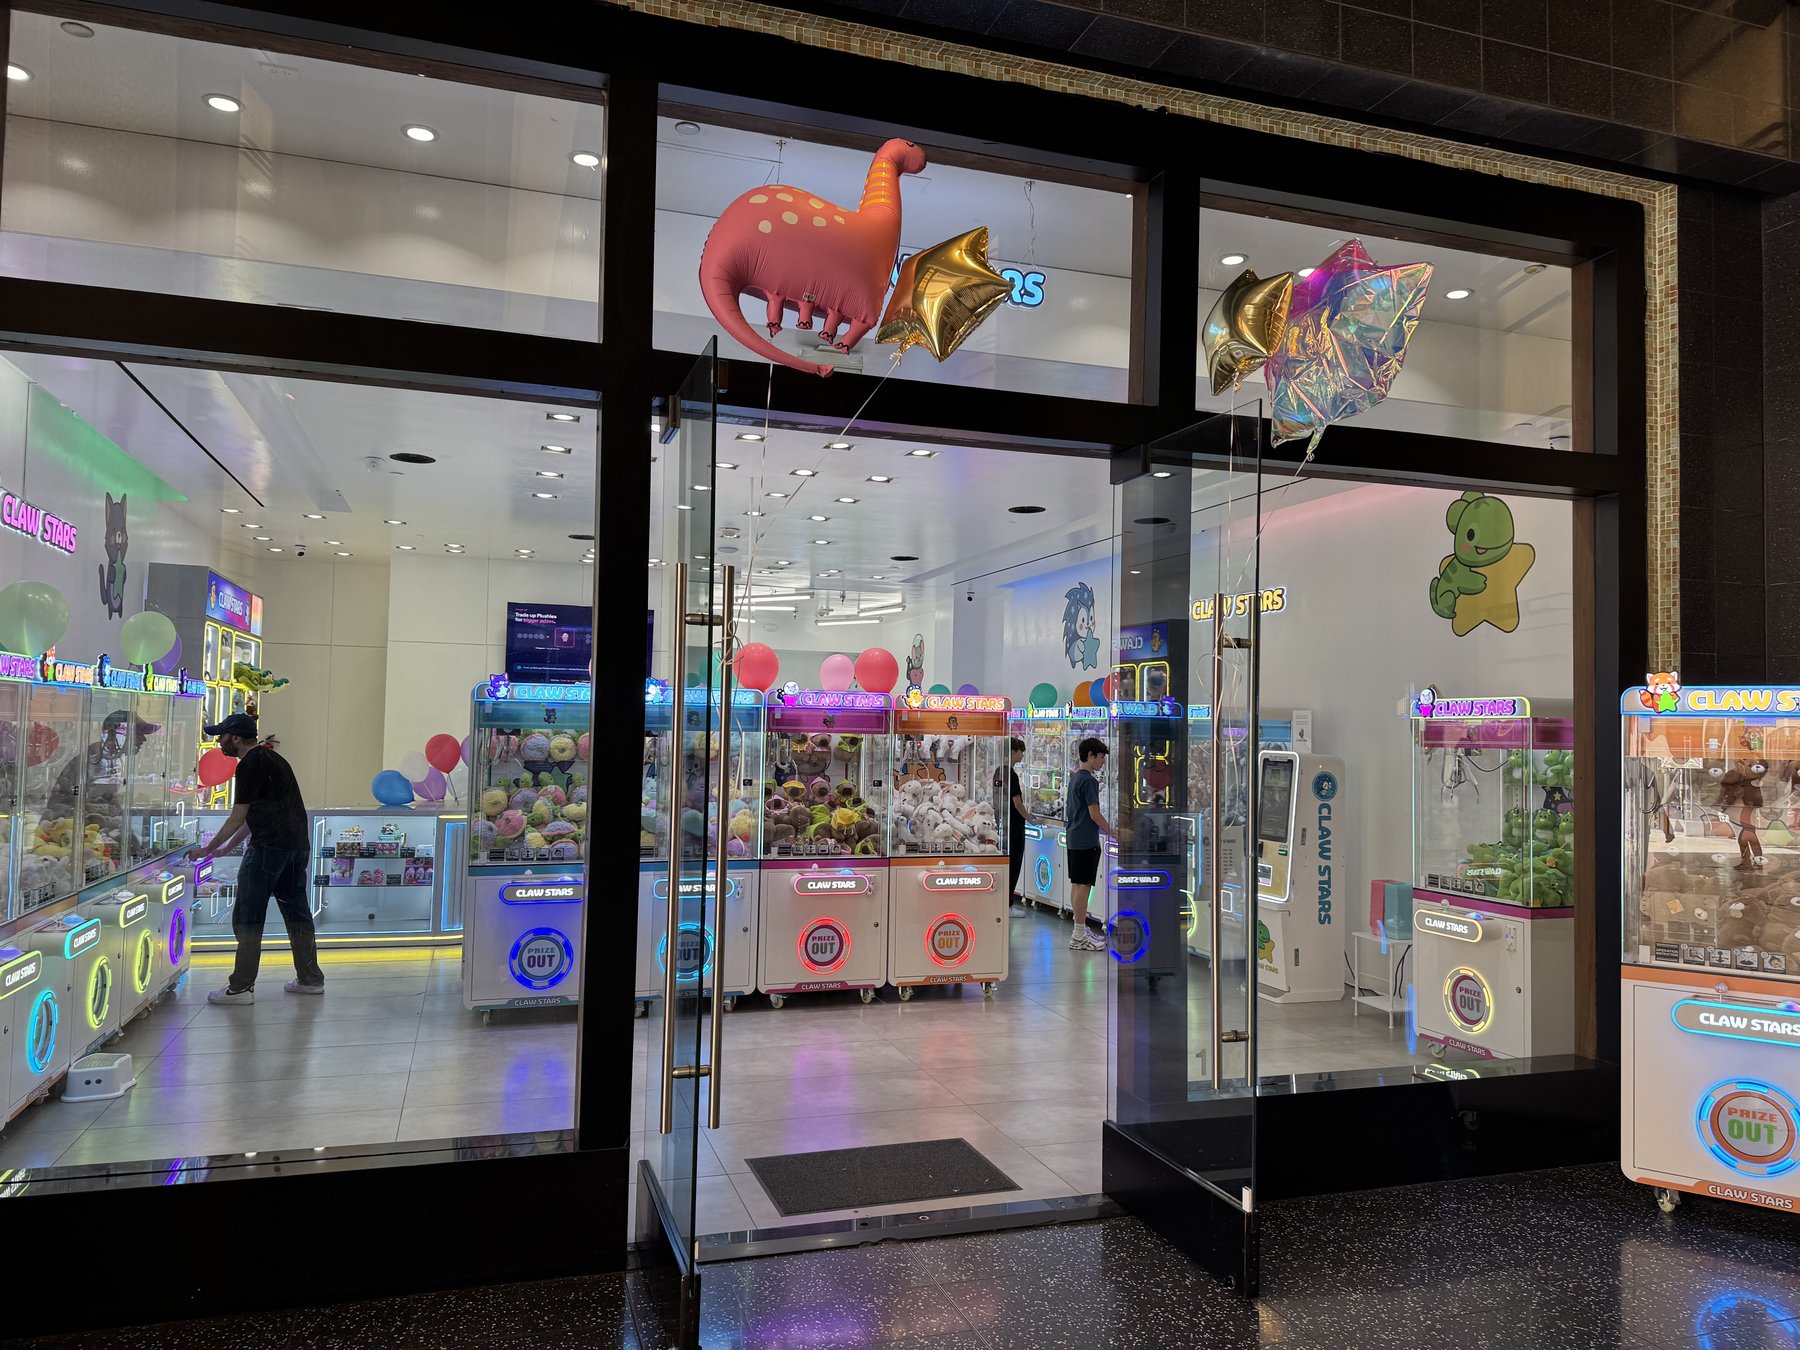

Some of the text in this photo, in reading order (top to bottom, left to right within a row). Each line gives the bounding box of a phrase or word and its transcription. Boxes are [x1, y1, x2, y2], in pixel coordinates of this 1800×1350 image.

[2, 494, 77, 552] CLAW STARS
[10, 656, 36, 678] STARS
[55, 663, 75, 682] CLAW
[515, 686, 590, 701] CLAW STA
[802, 692, 884, 707] CLAW STARS
[1688, 690, 1772, 711] CLAW
[927, 696, 1005, 710] CLAW STARS
[1435, 700, 1515, 716] CLAW STARS
[1318, 802, 1332, 925] CLAW STARS
[808, 881, 856, 889] CLAW STARS
[936, 876, 981, 886] CLAW STARS
[516, 887, 573, 897] CLAW STARS
[1425, 917, 1469, 934] CLAW STARS
[811, 942, 836, 955] OUT
[937, 937, 960, 949] OUT
[527, 954, 555, 968] OUT
[677, 948, 700, 961] UT
[5, 969, 21, 987] CLAW
[1459, 986, 1482, 998] PRIZE
[1459, 994, 1482, 1013] OUT
[1699, 1012, 1800, 1036] CLAW STARS
[1449, 1038, 1486, 1056] CLAW STARS
[1727, 1107, 1778, 1123] PRIZE
[1727, 1118, 1777, 1145] OUT
[1708, 1184, 1793, 1209] CLAW STARS
